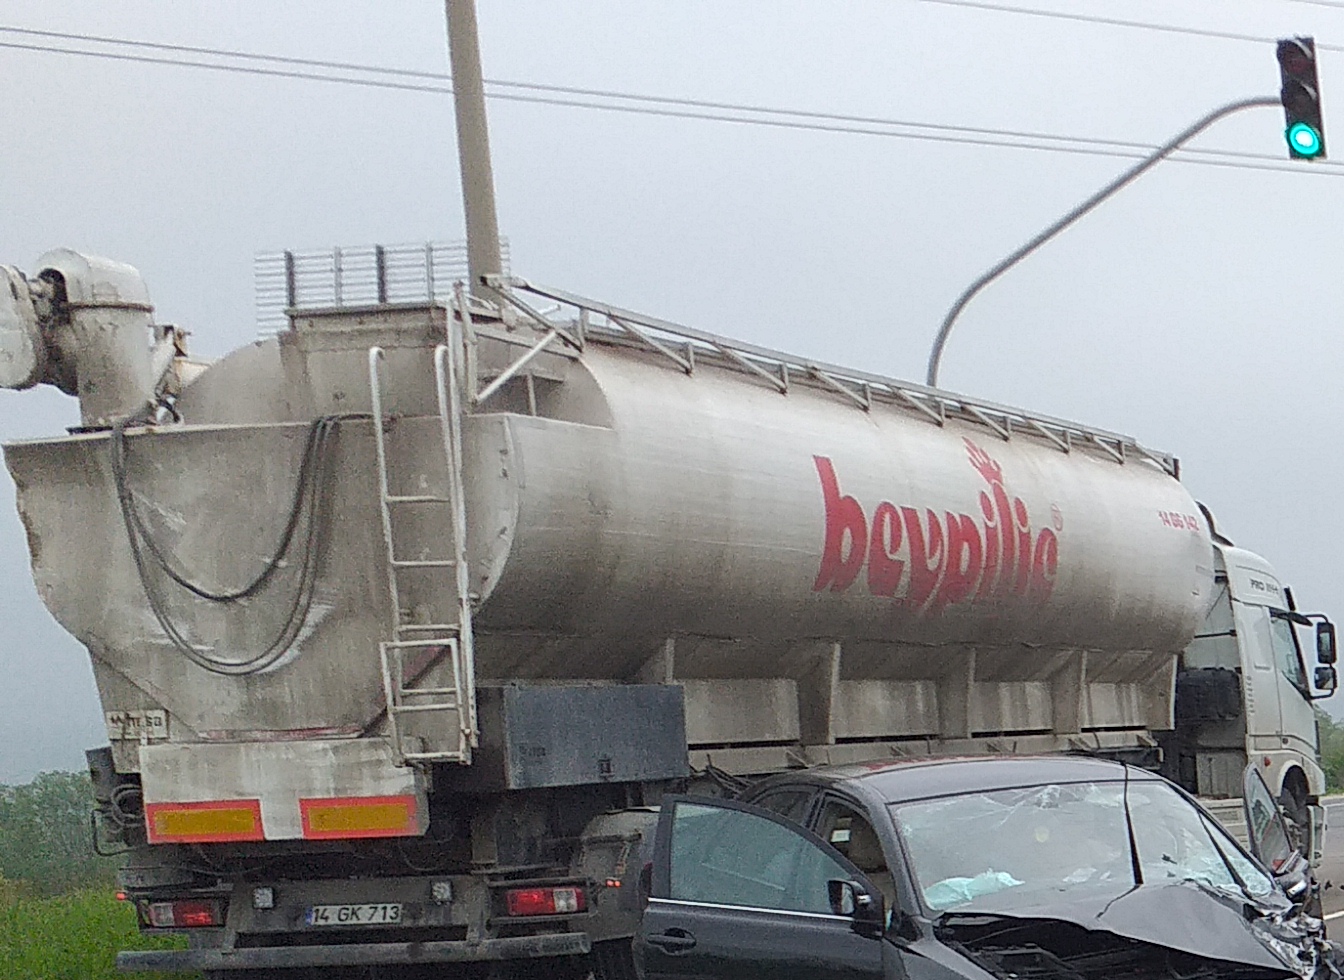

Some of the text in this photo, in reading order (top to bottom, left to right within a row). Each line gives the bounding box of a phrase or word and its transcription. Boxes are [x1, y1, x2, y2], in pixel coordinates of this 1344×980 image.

[314, 905, 400, 922] 14 GK 713
